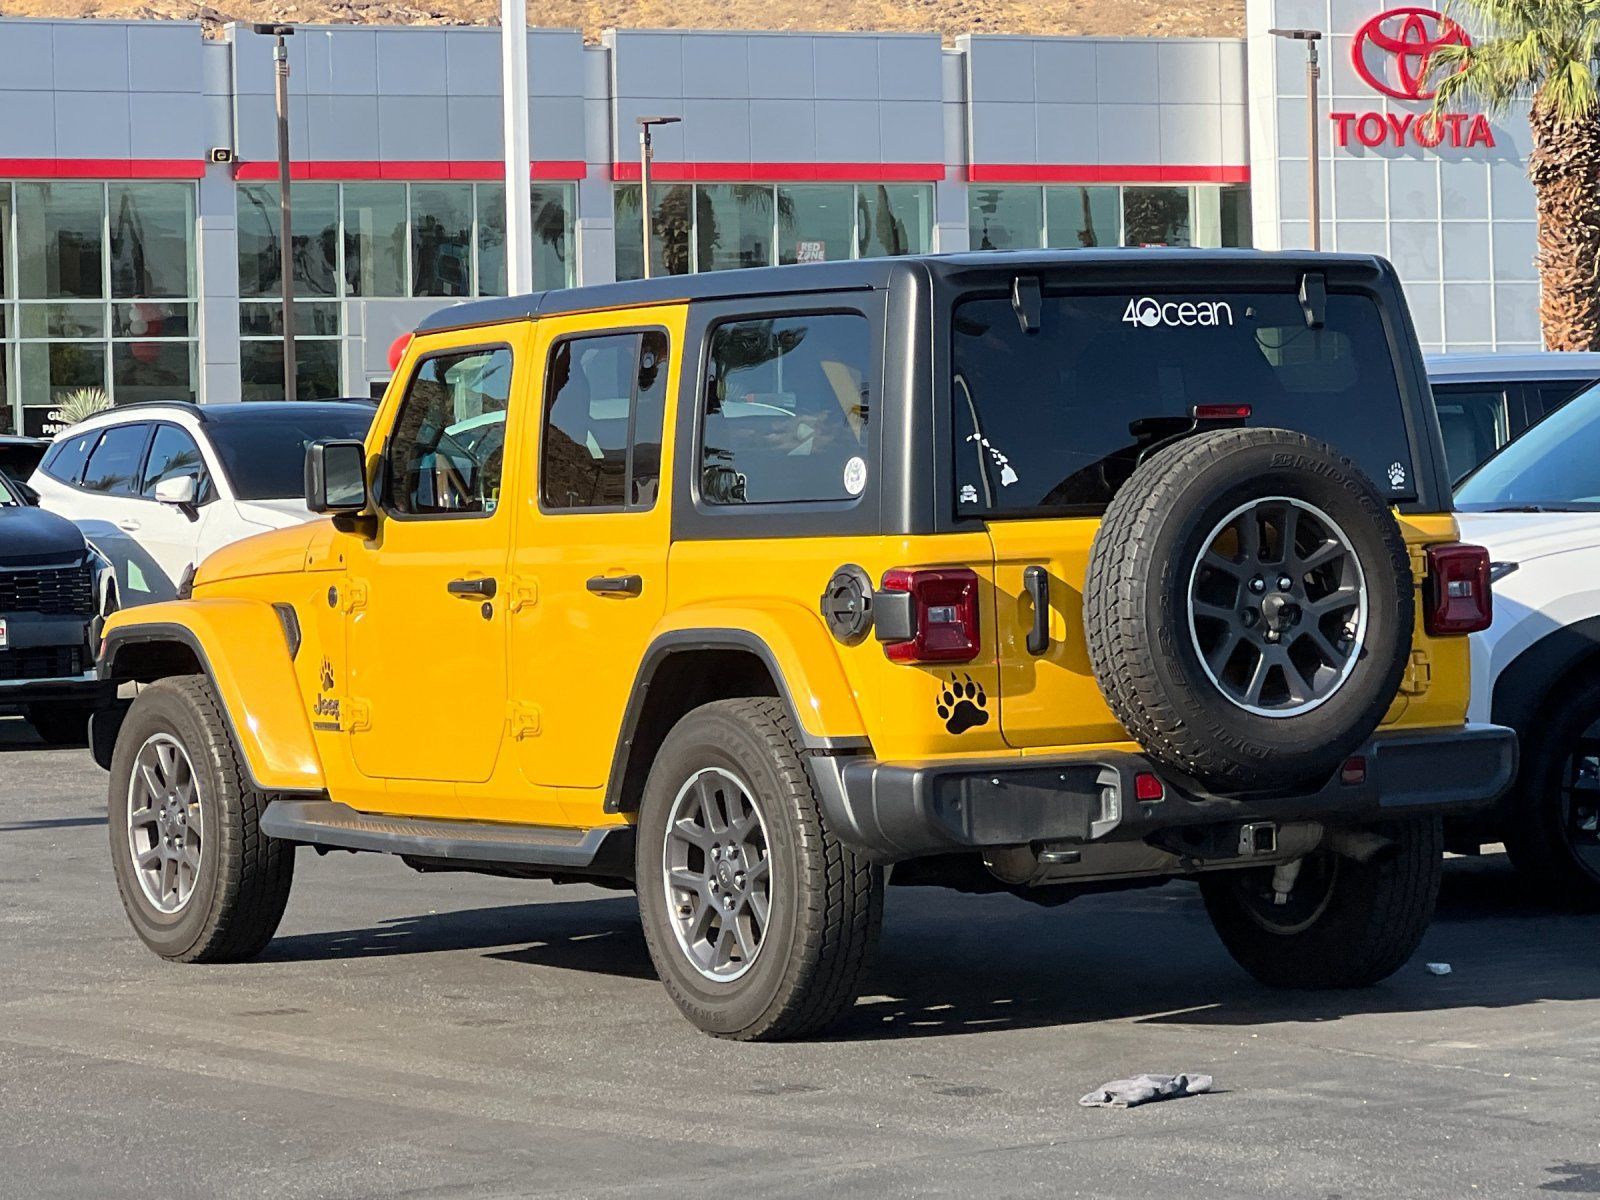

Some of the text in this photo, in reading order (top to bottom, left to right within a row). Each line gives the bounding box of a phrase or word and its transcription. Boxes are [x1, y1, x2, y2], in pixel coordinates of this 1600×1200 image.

[1329, 112, 1496, 148] TOYOTA
[797, 250, 825, 260] ZONE
[801, 242, 821, 251] RED
[313, 693, 340, 721] Jeep
